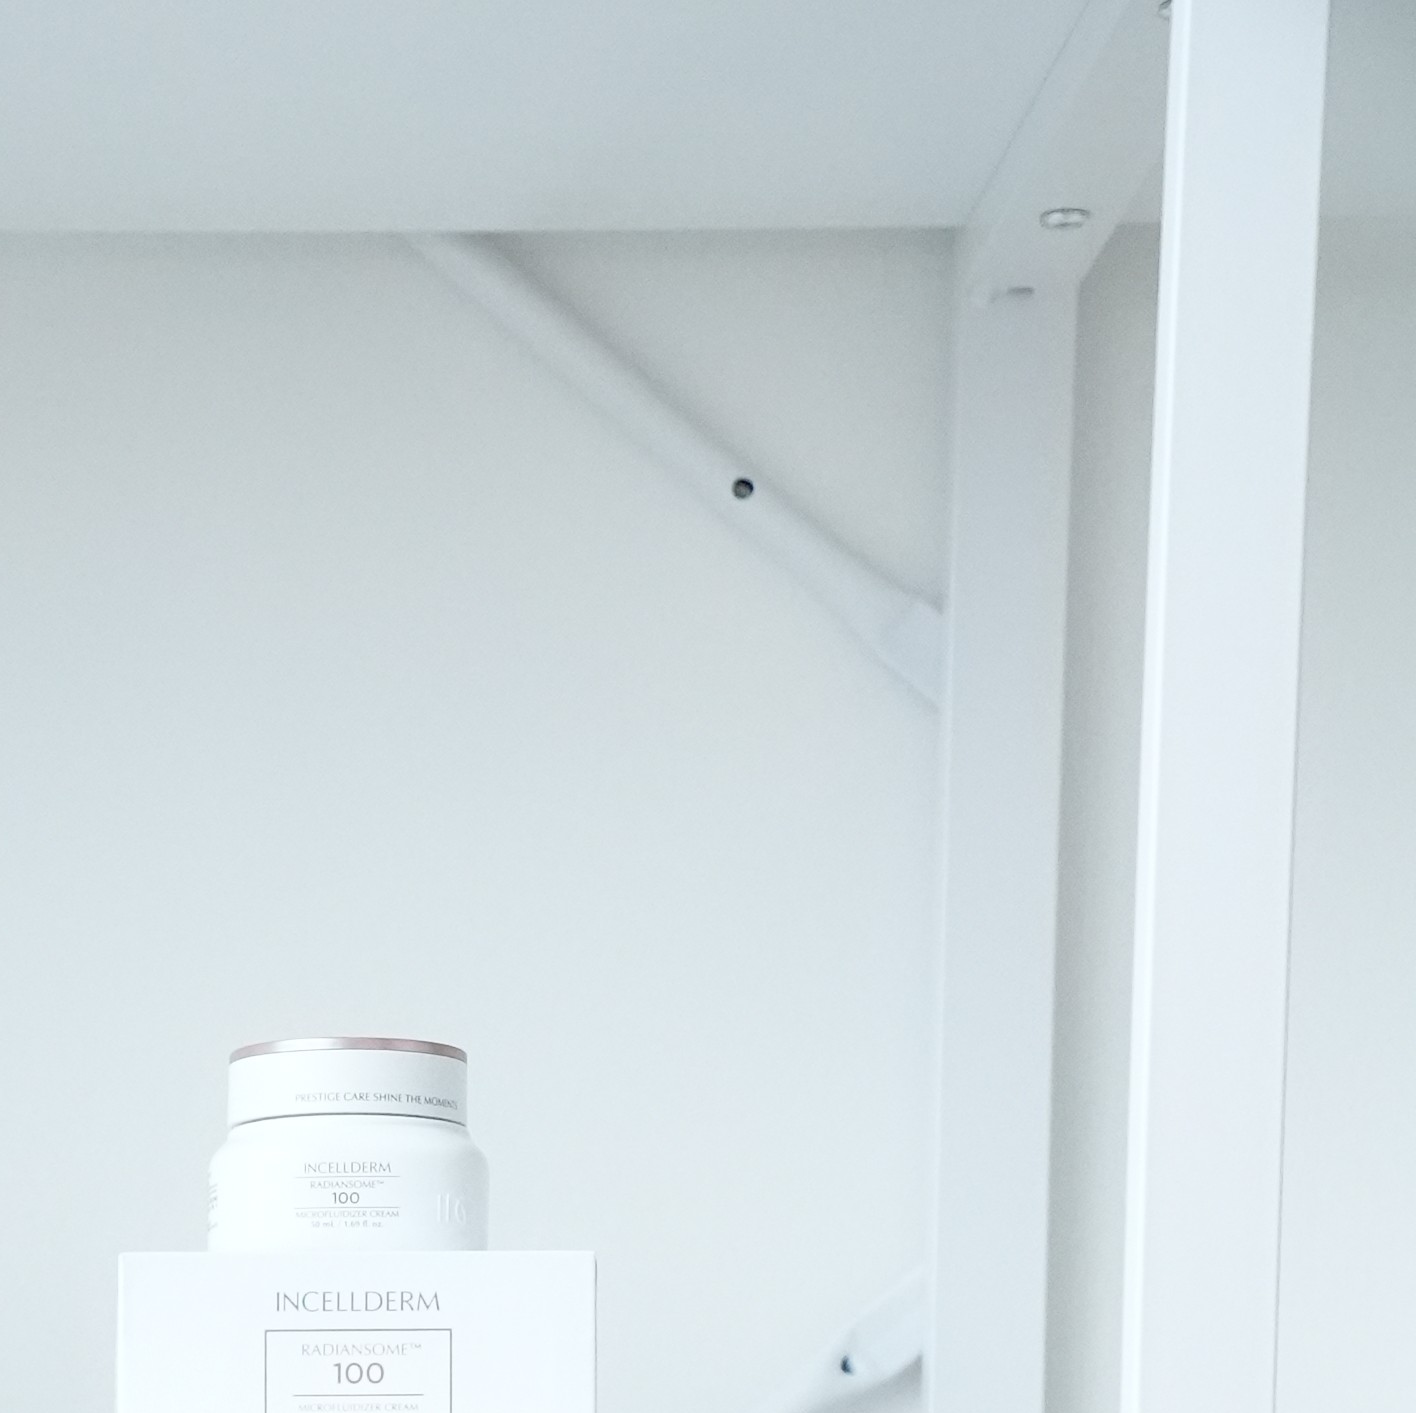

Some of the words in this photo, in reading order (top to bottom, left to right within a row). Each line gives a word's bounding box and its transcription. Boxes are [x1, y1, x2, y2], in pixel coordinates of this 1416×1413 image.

[295, 1092, 339, 1102] PRESTIGE
[343, 1092, 370, 1101] CARE
[373, 1093, 402, 1102] SHINE
[405, 1094, 421, 1104] THE
[303, 1161, 392, 1174] INCELLDERM
[332, 1191, 360, 1205] 100
[369, 1210, 400, 1218] CREAM
[276, 1291, 441, 1312] INCELLDERM
[333, 1362, 385, 1385] 100
[384, 1403, 419, 1411] CREAM
